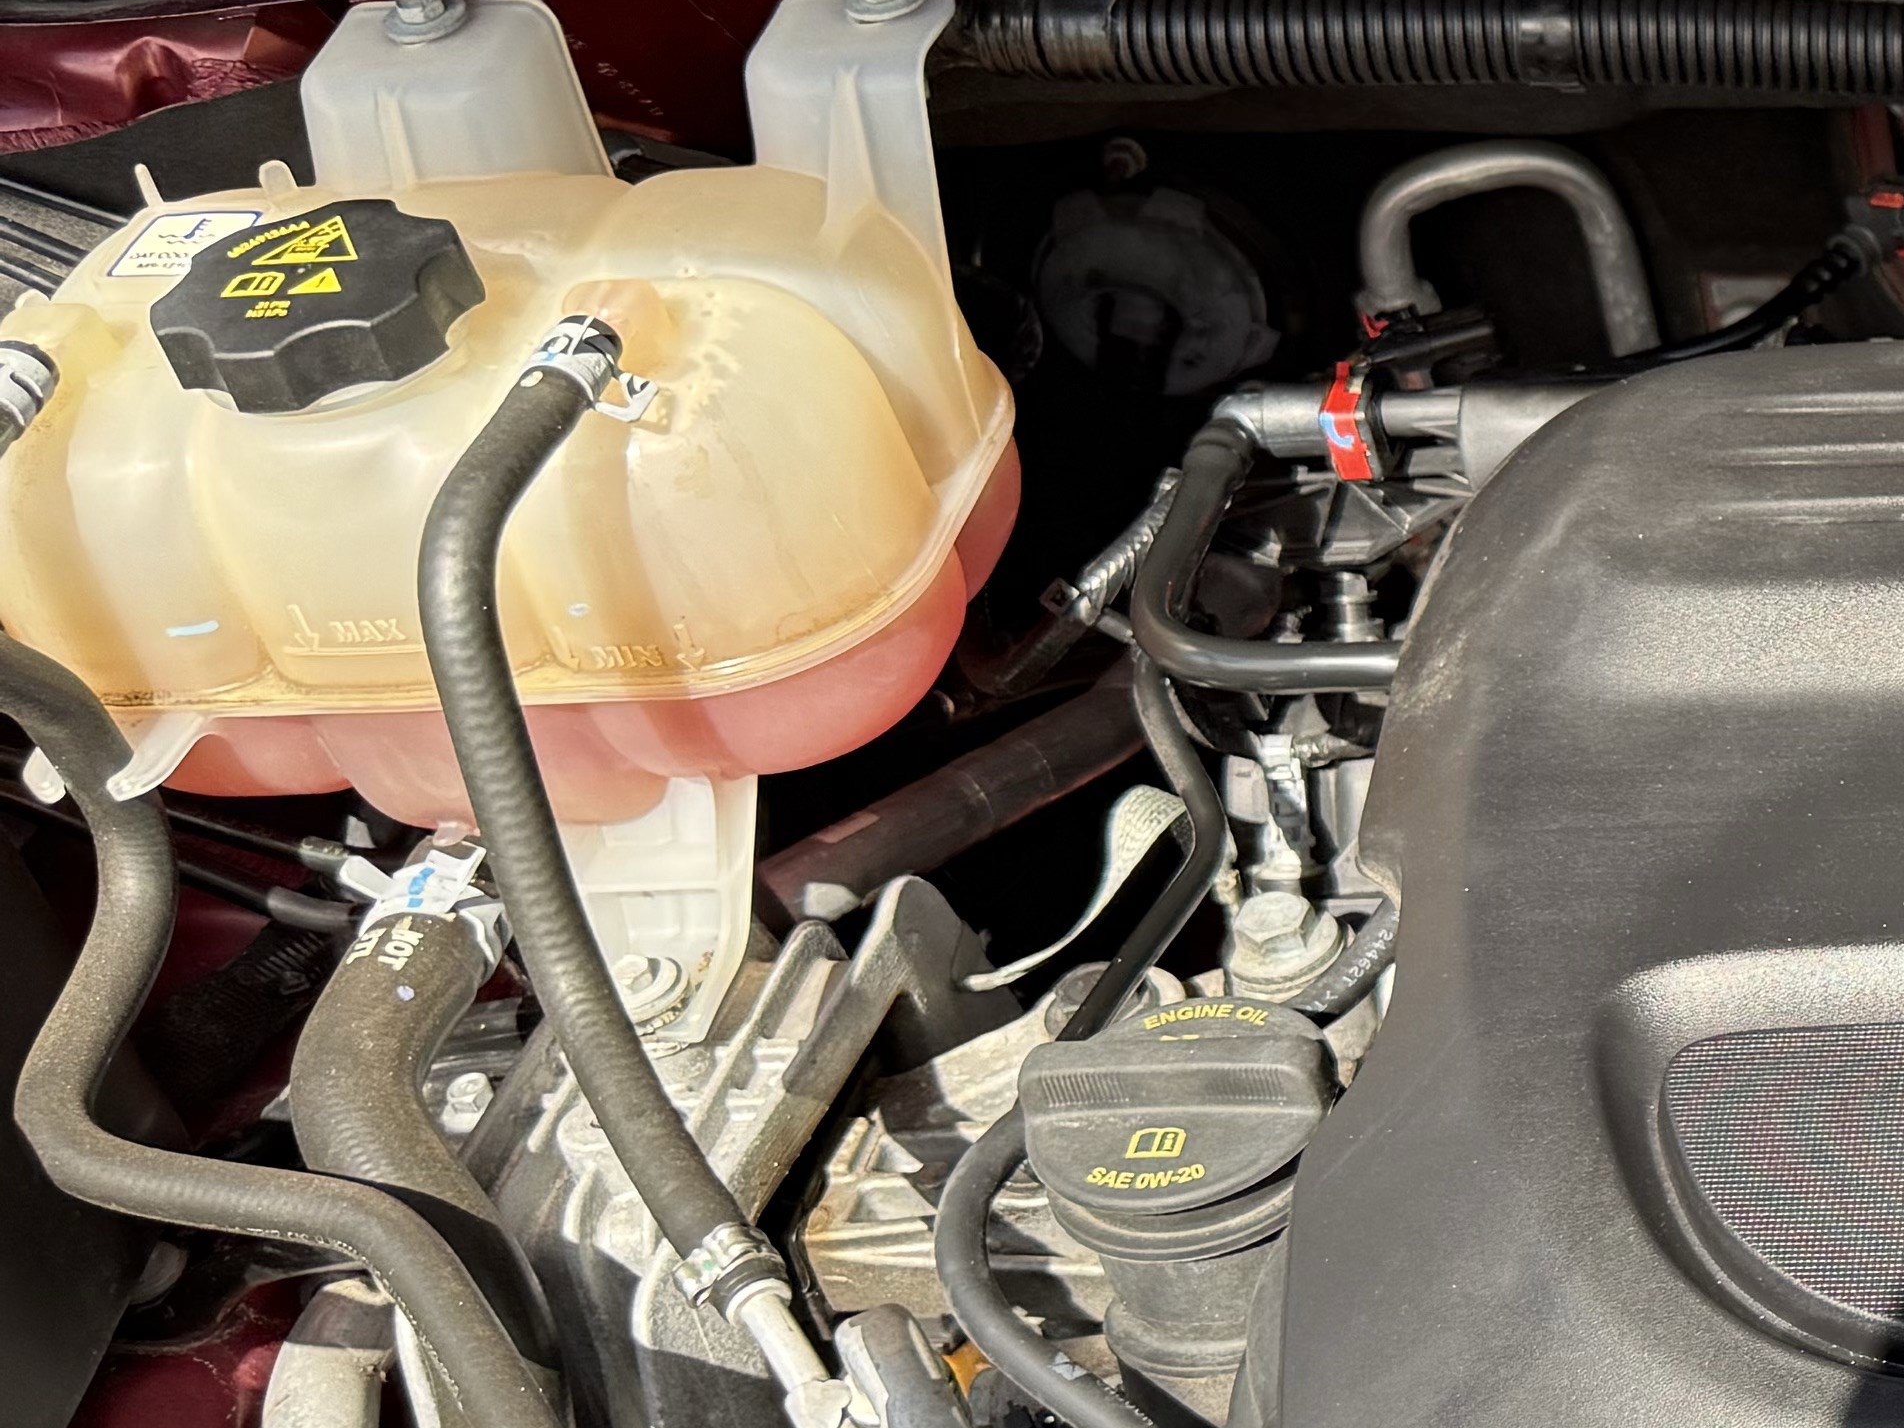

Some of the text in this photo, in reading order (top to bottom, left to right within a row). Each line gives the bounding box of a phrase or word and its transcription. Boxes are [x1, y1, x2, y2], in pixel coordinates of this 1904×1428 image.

[329, 618, 406, 643] MAX
[590, 643, 663, 670] MIN
[1143, 1004, 1269, 1030] ENGINE OIL
[1086, 1163, 1206, 1190] SAE 0W-20
